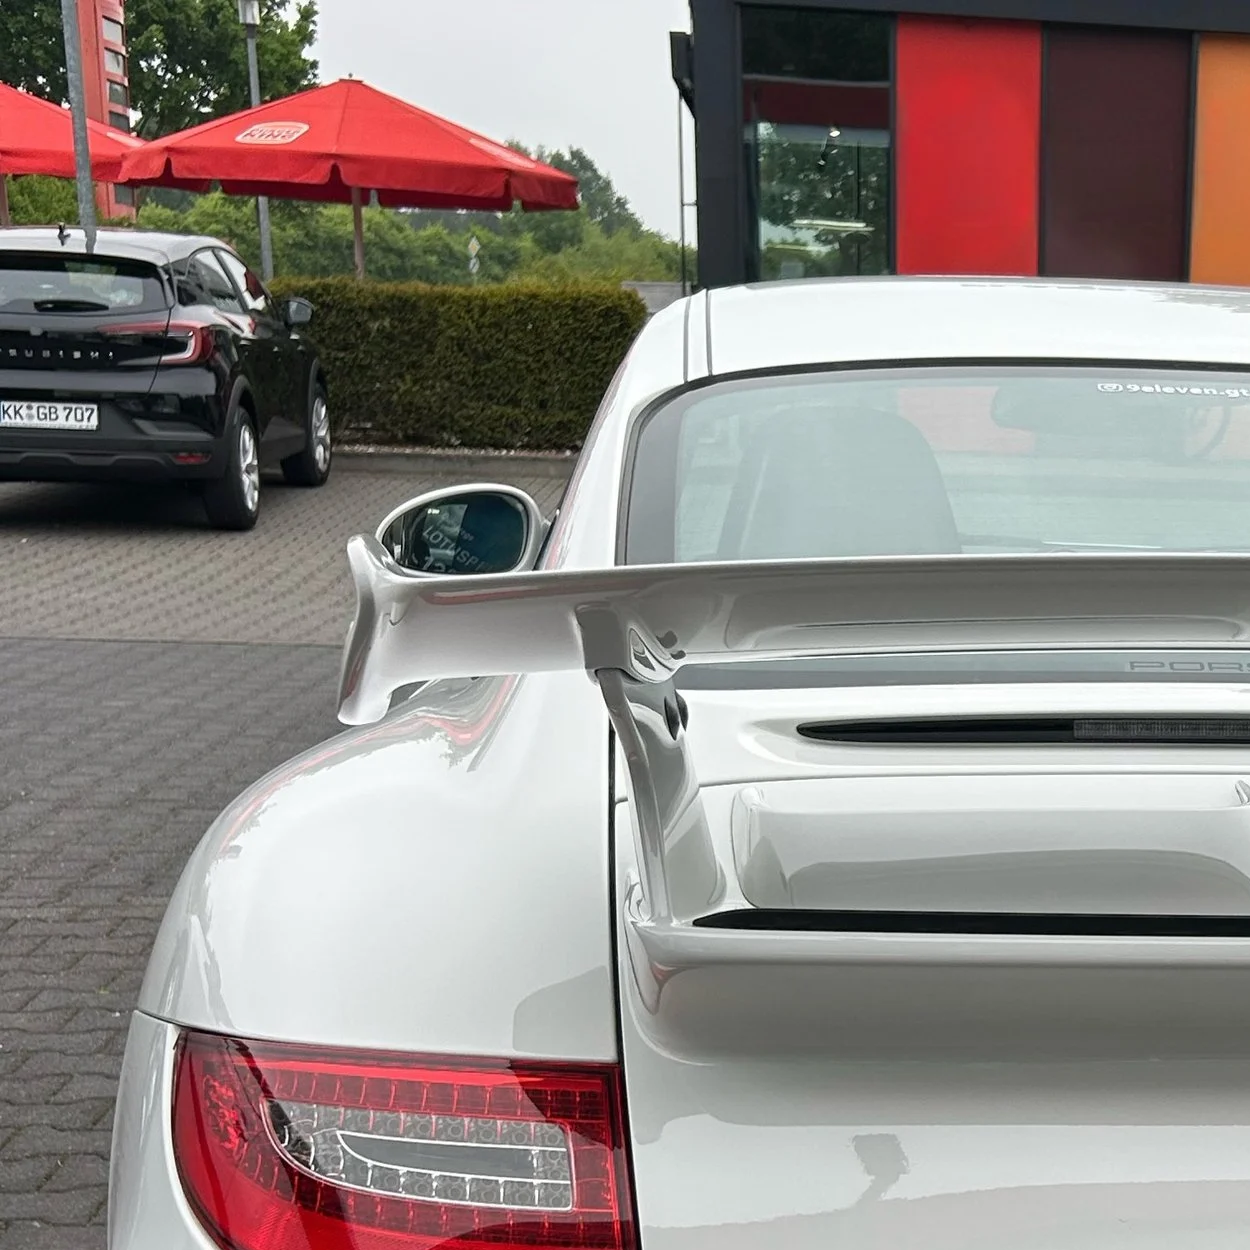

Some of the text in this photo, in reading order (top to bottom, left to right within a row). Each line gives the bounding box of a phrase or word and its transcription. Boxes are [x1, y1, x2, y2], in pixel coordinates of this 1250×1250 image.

[0, 347, 113, 360] SUBISHI
[2, 404, 95, 422] KK GB 707
